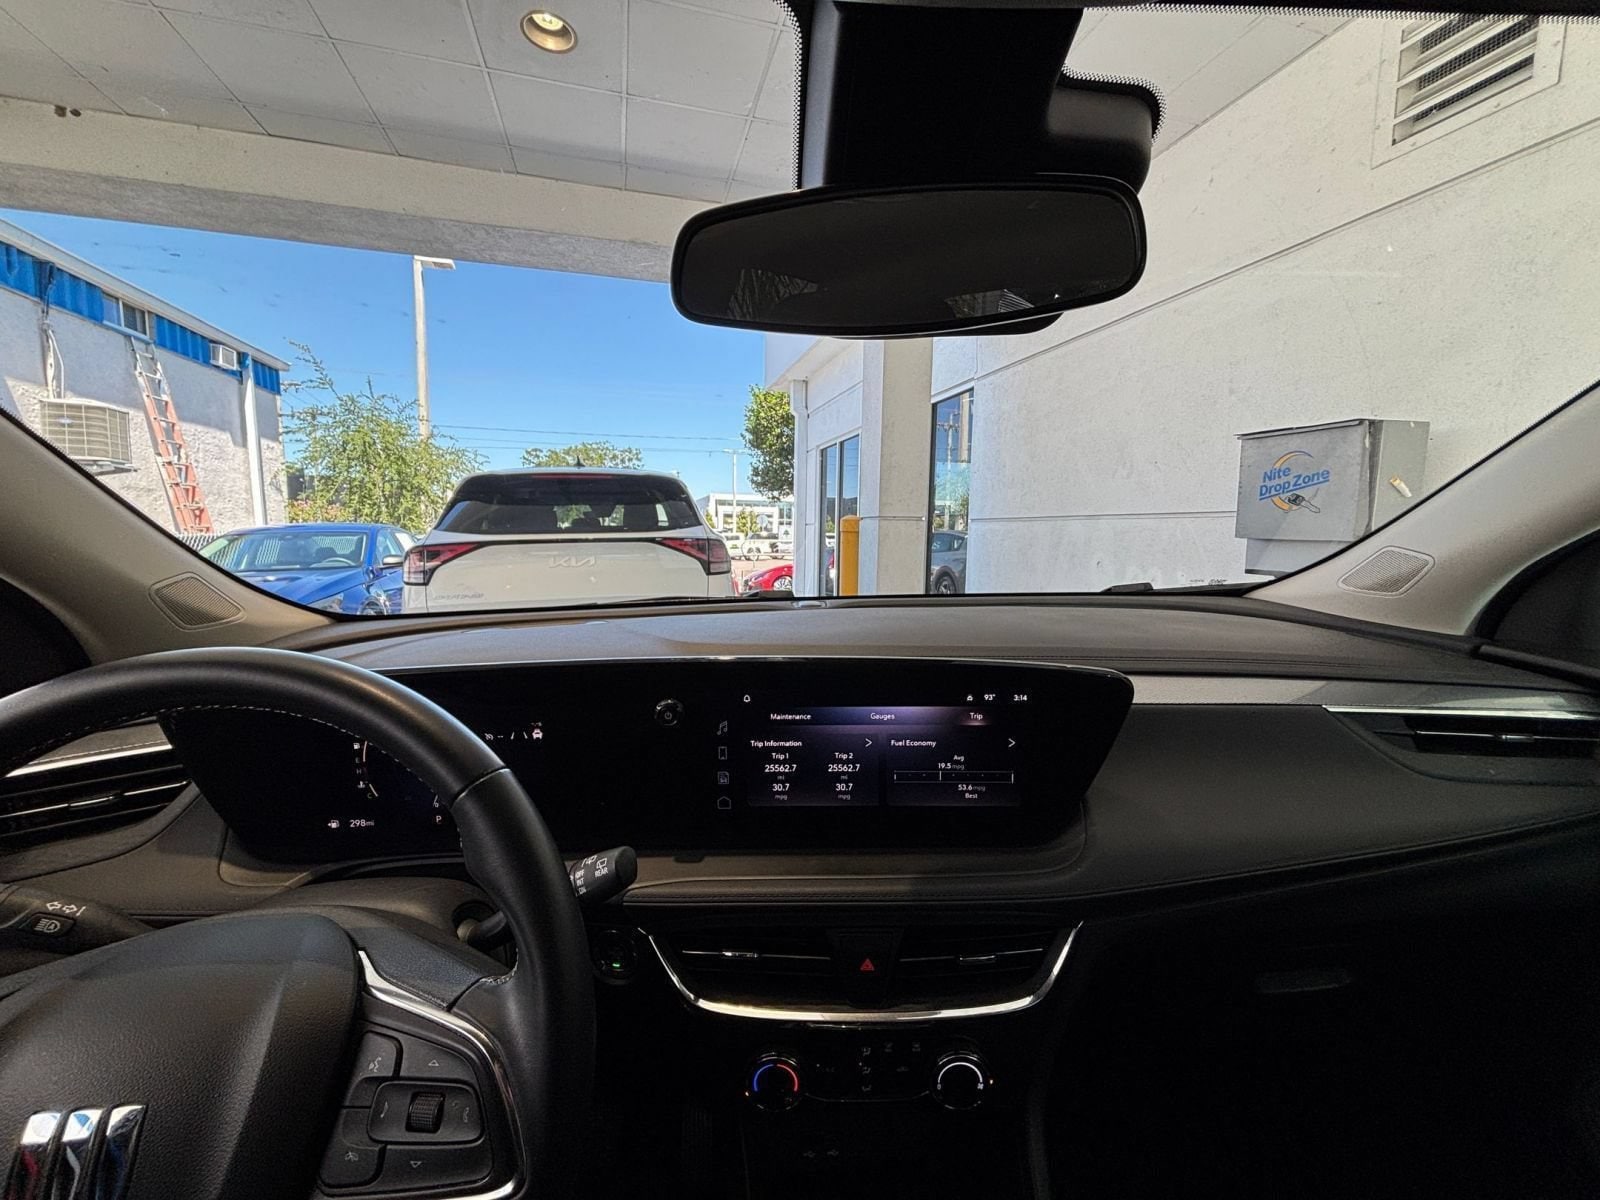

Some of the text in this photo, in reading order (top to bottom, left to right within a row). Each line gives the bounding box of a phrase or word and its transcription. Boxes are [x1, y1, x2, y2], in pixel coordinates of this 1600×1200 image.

[1263, 466, 1291, 482] Nite
[1259, 469, 1330, 497] Drop Zone
[549, 555, 596, 568] KIA
[770, 713, 812, 721] Maintenance
[870, 712, 895, 721] Gauges
[969, 712, 983, 721] Trip
[750, 739, 803, 749] Trip Information
[890, 739, 937, 749] Fuel Economy
[771, 752, 785, 761] Trip
[834, 751, 849, 761] Trip
[953, 754, 965, 763] Avg
[764, 764, 798, 773] 25562.7
[827, 764, 861, 773] 25562.7
[771, 783, 790, 792] 30.7
[835, 783, 854, 792] 30.7
[774, 793, 788, 801] mpg
[837, 793, 851, 801] mpg
[436, 816, 442, 824] P
[595, 867, 608, 877] REAR
